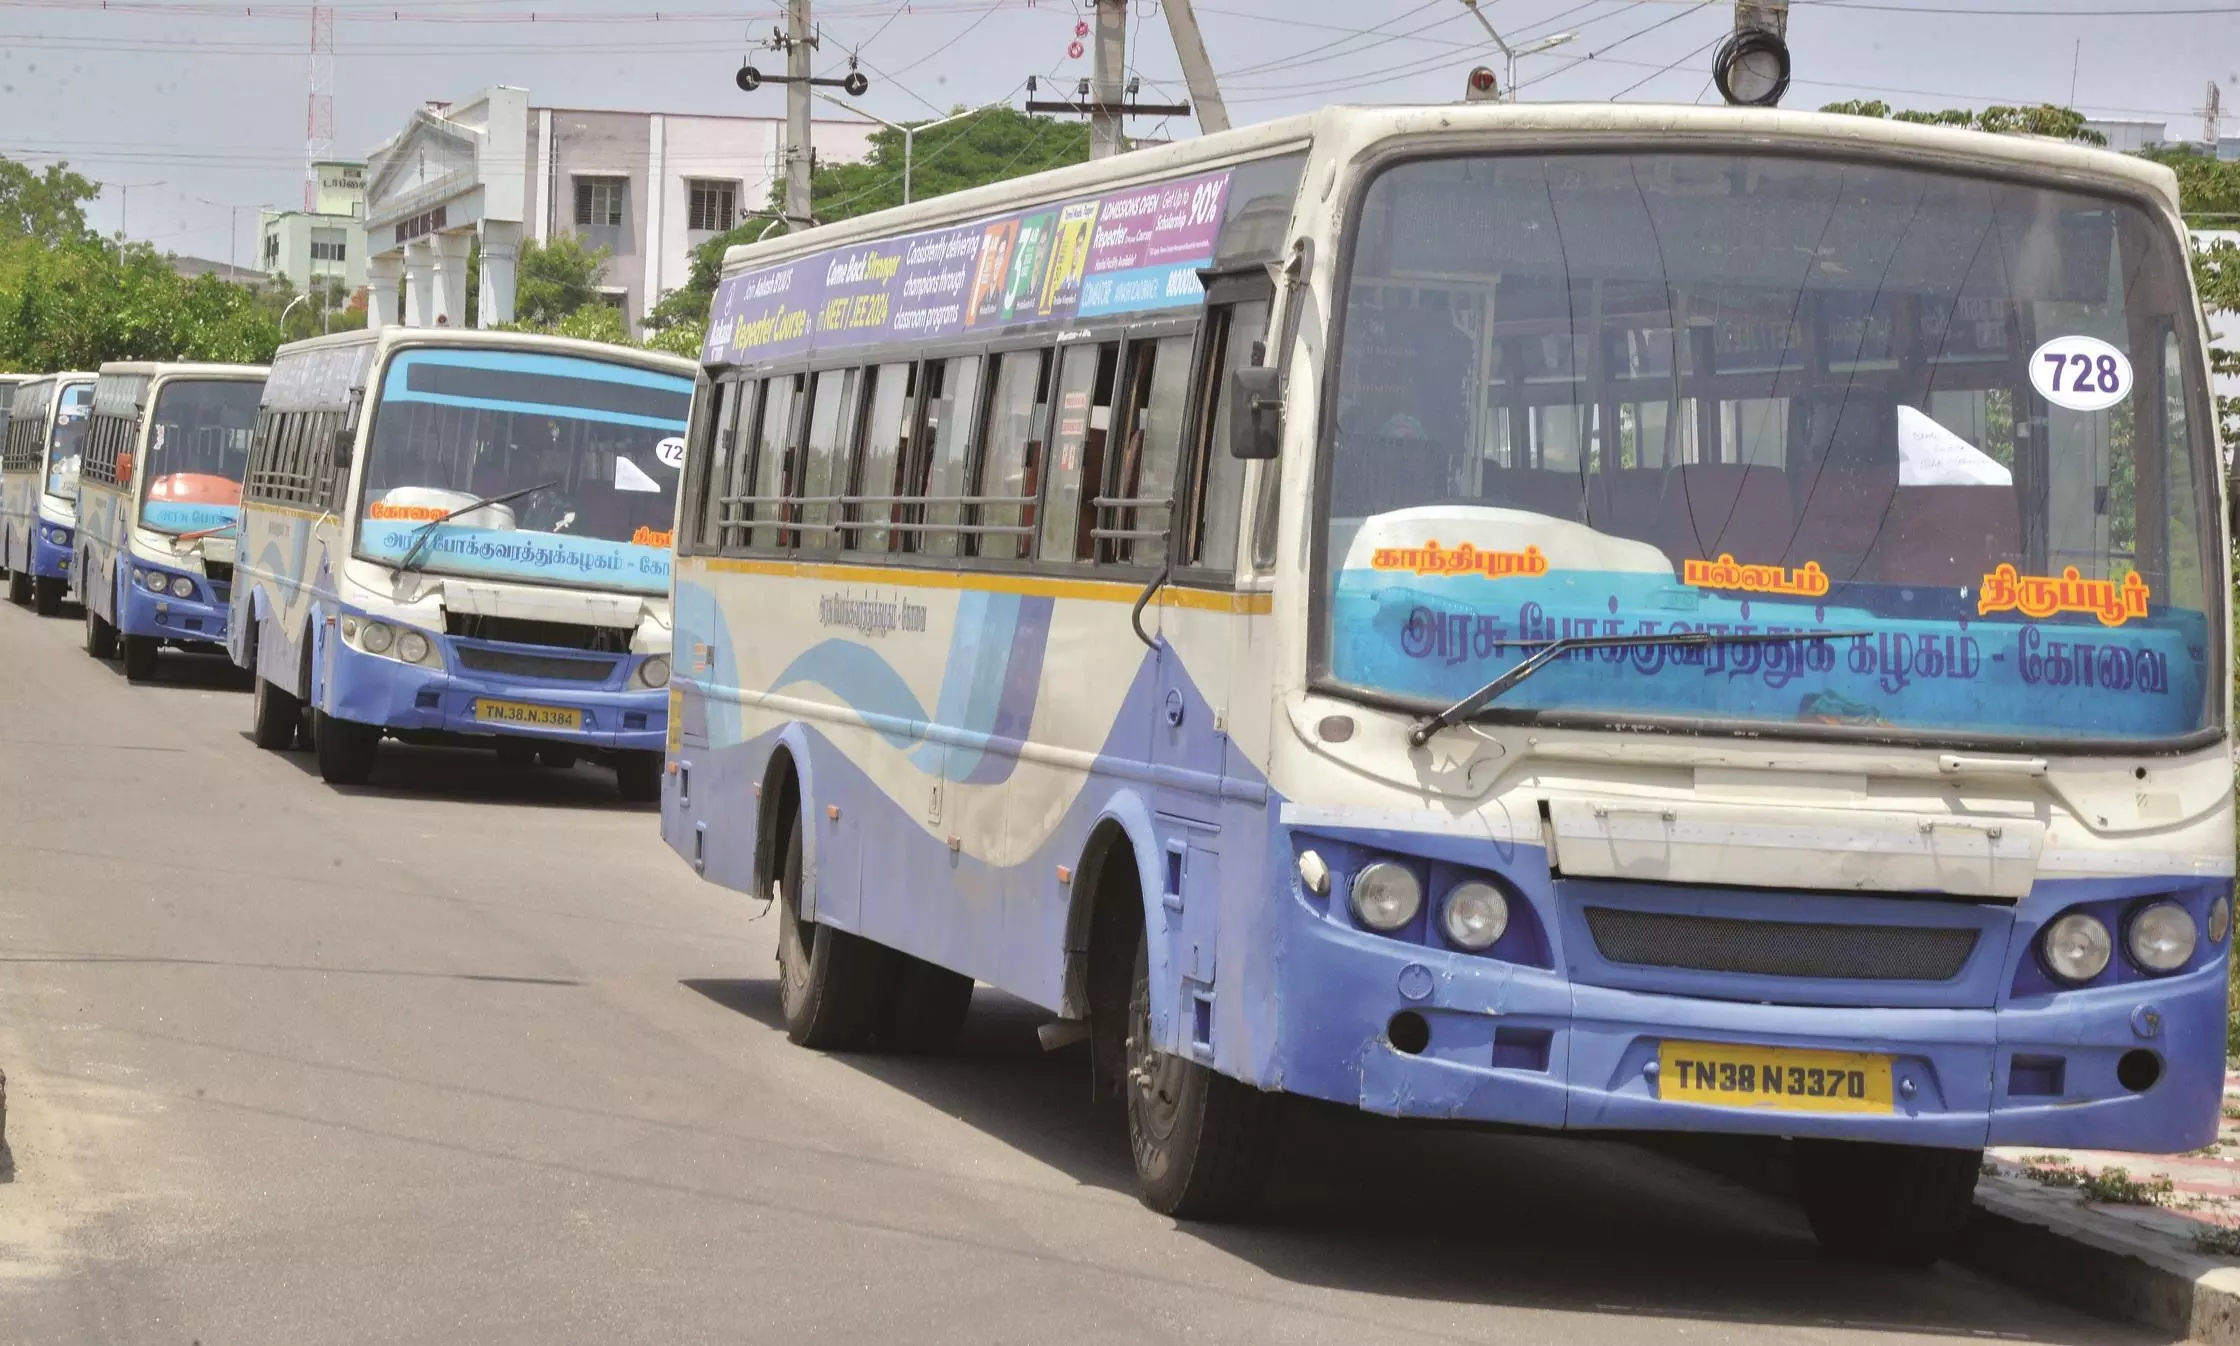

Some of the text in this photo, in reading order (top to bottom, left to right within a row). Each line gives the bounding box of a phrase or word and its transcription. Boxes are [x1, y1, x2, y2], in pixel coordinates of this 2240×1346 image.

[1100, 193, 1160, 222] ADMISSIONS OPEN
[1155, 211, 1188, 232] Scholarship
[906, 230, 981, 266] Consistently delivering
[1093, 223, 1128, 254] Repeater
[826, 250, 901, 287] Come Back Stronger
[903, 271, 940, 302] champions
[938, 263, 966, 297] through
[824, 296, 849, 331] NEET
[849, 294, 869, 328] JEE
[866, 292, 890, 326] 2024
[894, 303, 960, 333] classroom programs
[732, 310, 775, 359] Repeater
[774, 304, 806, 342] Course
[2043, 353, 2118, 394] 728
[663, 444, 683, 461] 72
[1371, 541, 1548, 579] காந்திபுரம்
[1684, 553, 1829, 596] பல்லடம்
[1978, 563, 2150, 626] திருப்பூர்
[1400, 604, 1506, 666] அரசு
[2018, 622, 2168, 695] கோவை
[486, 704, 573, 725] TN.38.N.3384
